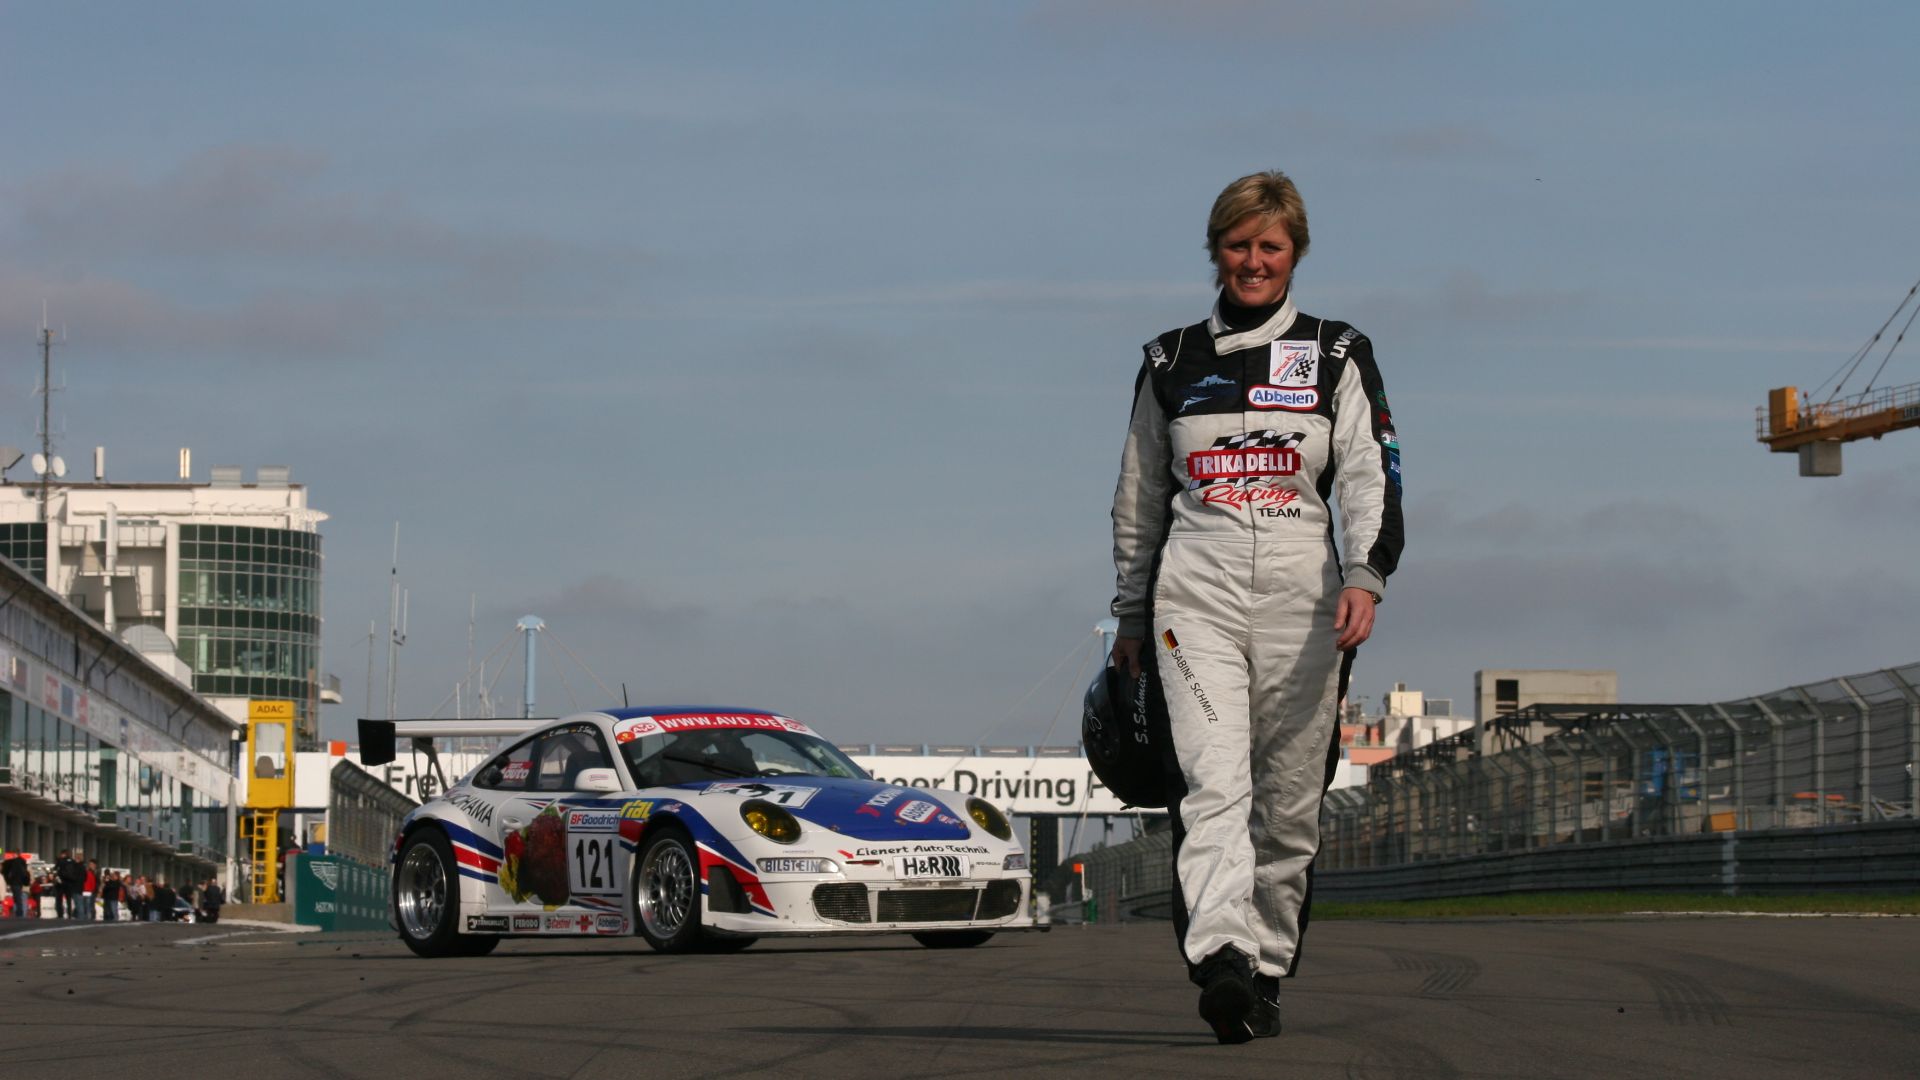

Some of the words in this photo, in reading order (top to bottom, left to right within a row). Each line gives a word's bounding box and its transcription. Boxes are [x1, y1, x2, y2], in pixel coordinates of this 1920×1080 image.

[1253, 390, 1314, 404] Abbelen
[1194, 453, 1292, 475] FRIKADELLI
[1201, 483, 1299, 511] Racing
[1257, 508, 1301, 518] TEAM
[1171, 648, 1195, 682] SABINE
[1190, 682, 1219, 724] SCHMITZ
[256, 705, 285, 714] ADAC
[954, 769, 1075, 806] Driving
[569, 813, 621, 826] BFGoodrich
[856, 846, 909, 856] Lienert
[947, 846, 990, 854] Technik
[575, 838, 615, 889] 121
[765, 860, 819, 872] BILSTEIN
[903, 856, 942, 876] H&R
